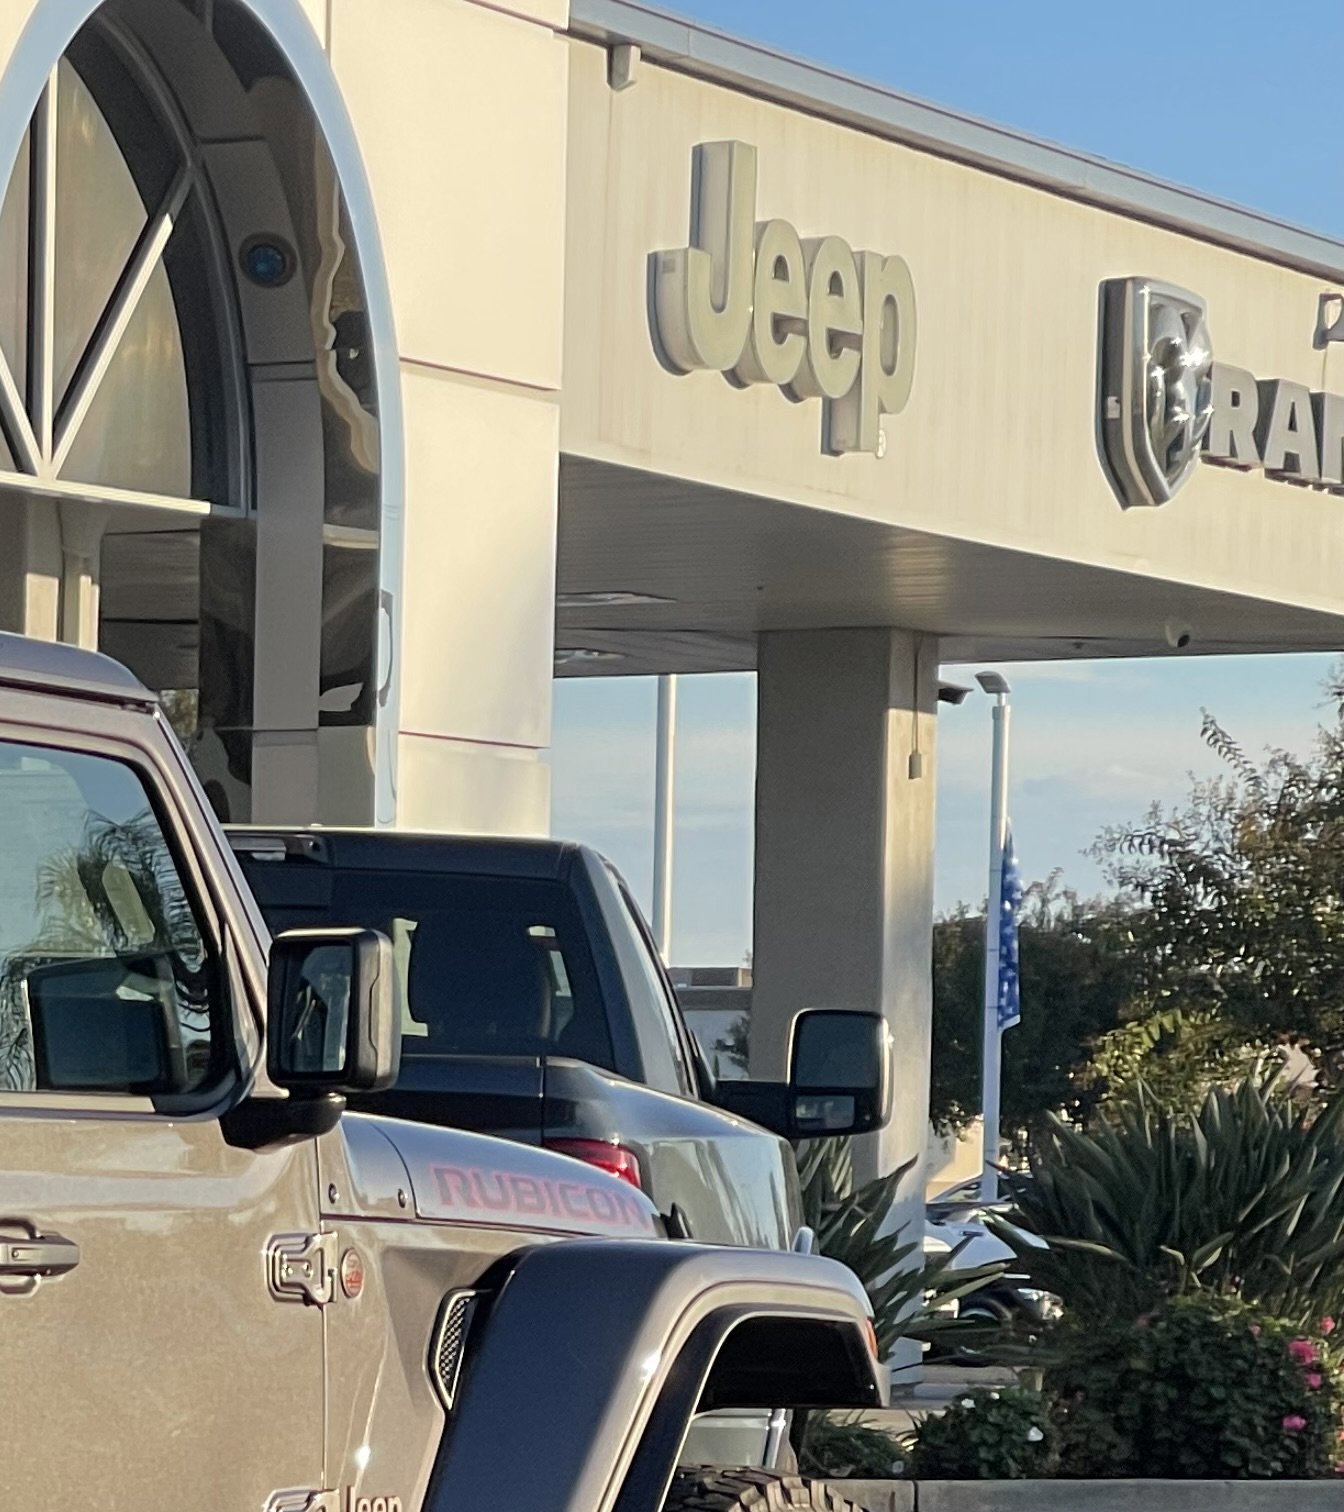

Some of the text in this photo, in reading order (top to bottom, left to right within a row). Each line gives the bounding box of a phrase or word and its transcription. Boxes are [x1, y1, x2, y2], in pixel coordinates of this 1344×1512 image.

[646, 139, 917, 457] Jeep
[1201, 360, 1344, 490] RA
[429, 1163, 652, 1231] RUBICON
